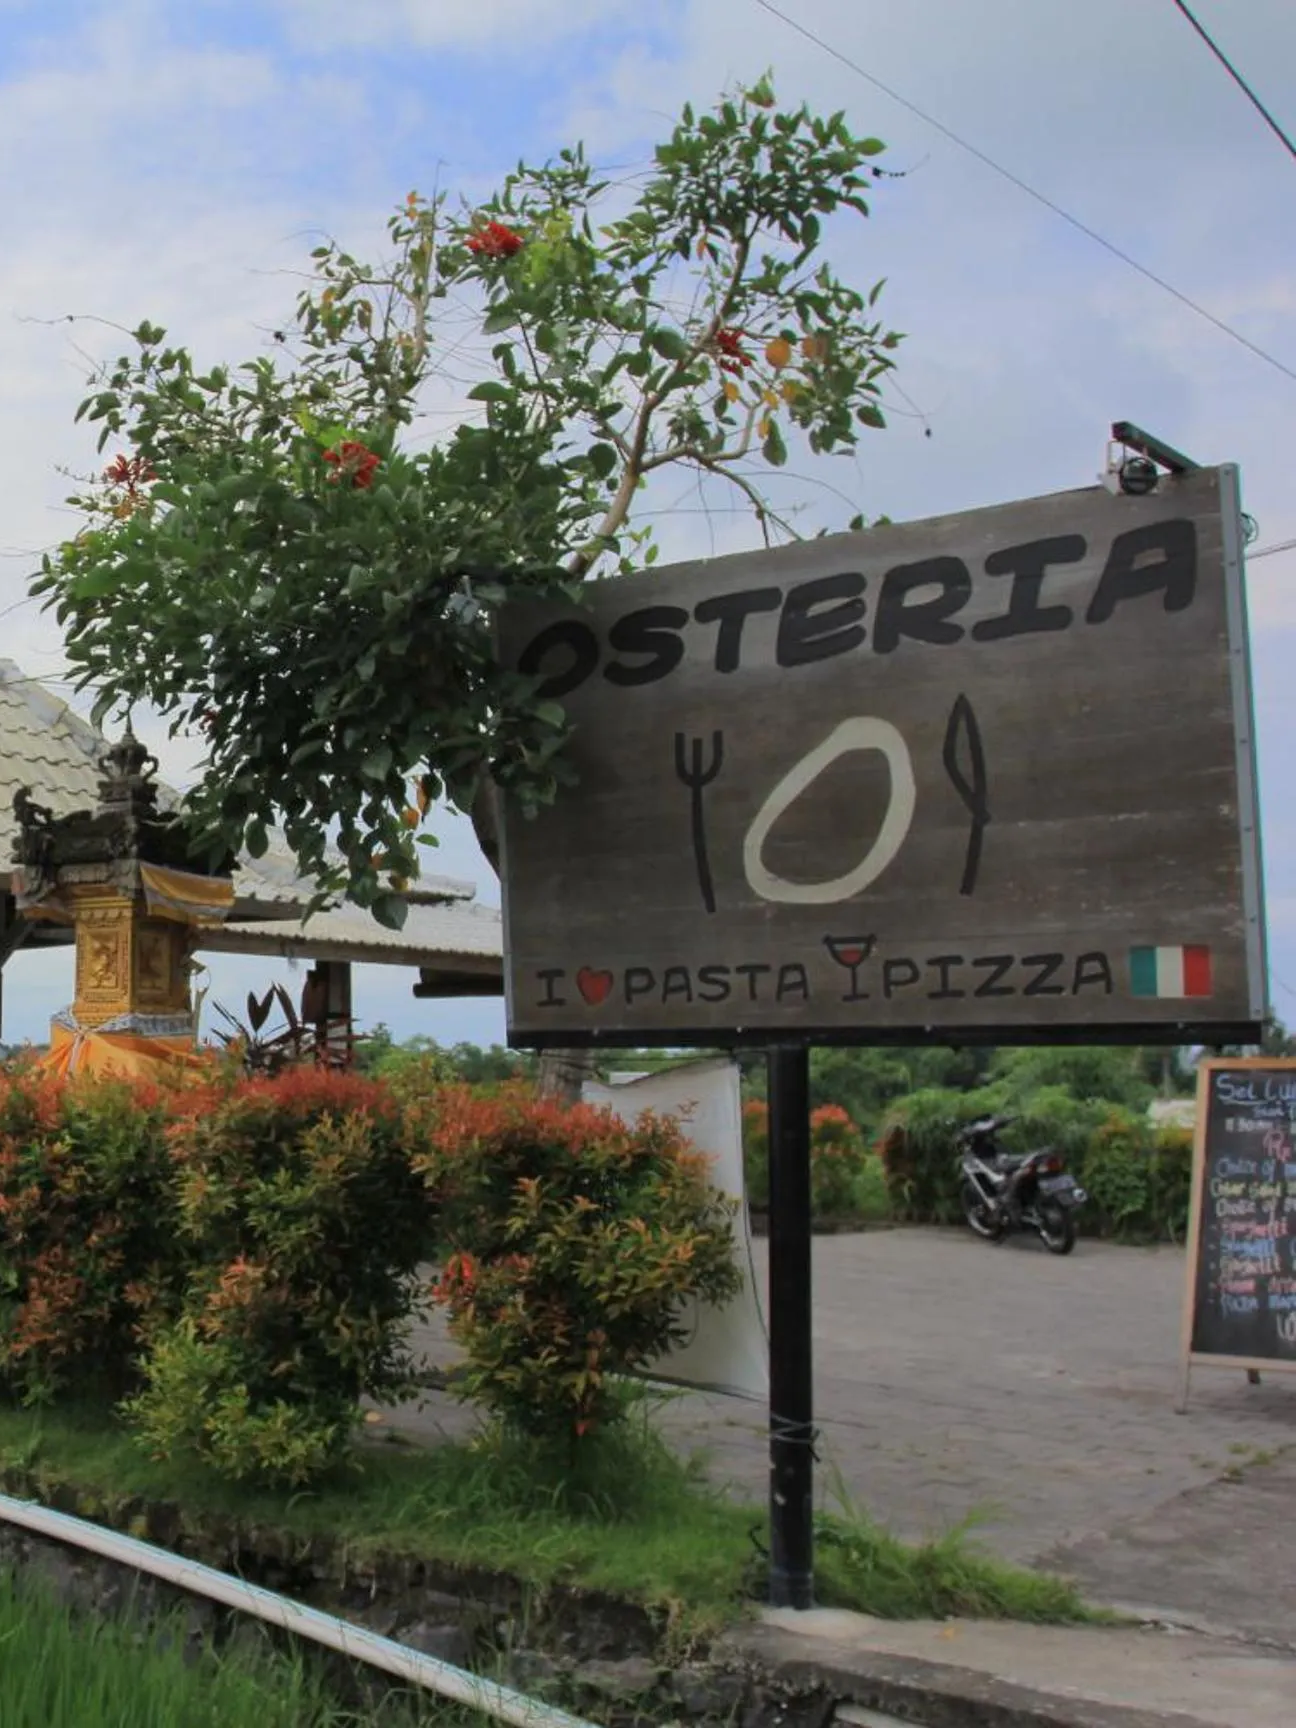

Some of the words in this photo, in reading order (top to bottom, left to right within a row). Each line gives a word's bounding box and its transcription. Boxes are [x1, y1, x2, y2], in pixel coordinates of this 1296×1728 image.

[517, 519, 1198, 699] OSTERIA
[536, 968, 566, 1008] I
[623, 963, 808, 1004] PASTA
[881, 951, 1115, 999] PIZZA
